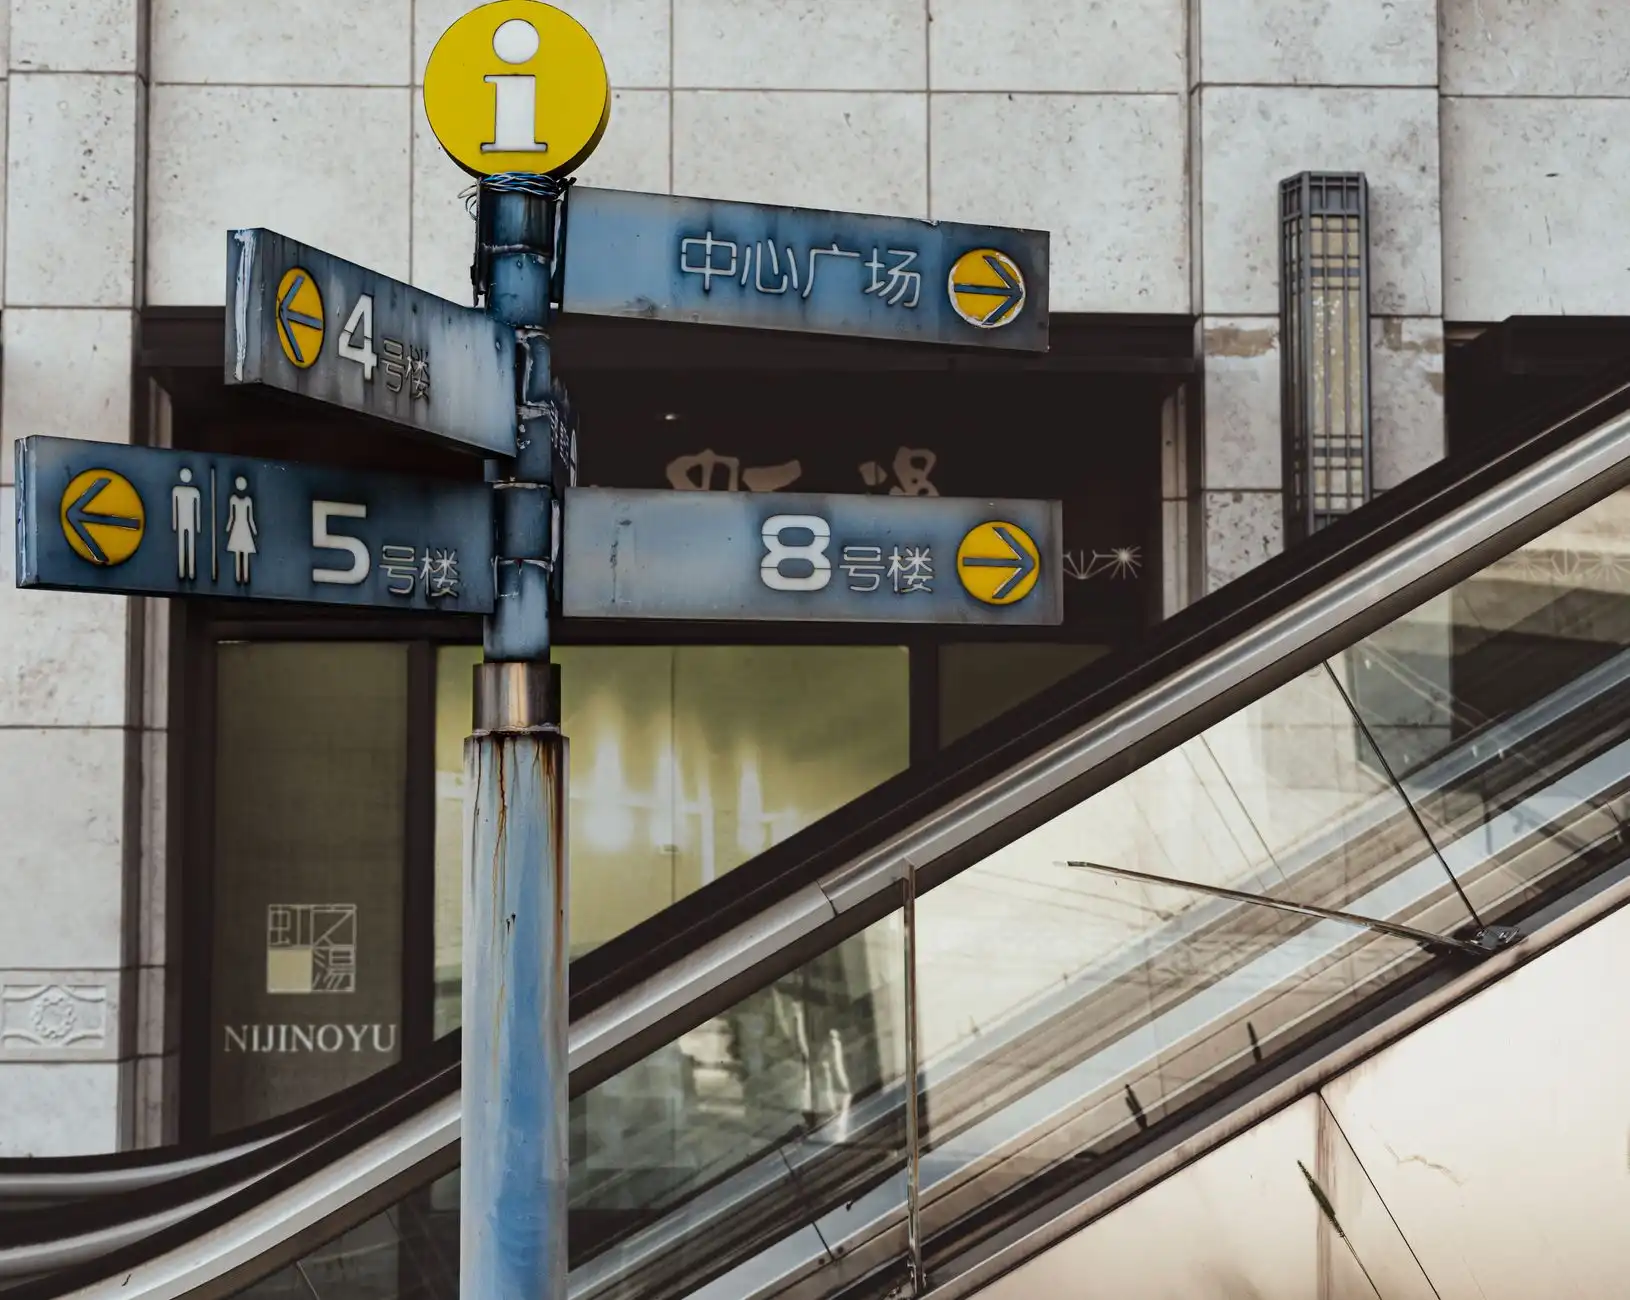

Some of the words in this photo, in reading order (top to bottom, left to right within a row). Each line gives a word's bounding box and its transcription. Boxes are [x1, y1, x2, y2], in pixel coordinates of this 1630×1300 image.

[680, 231, 921, 309] 中心广场
[338, 293, 430, 402] 4号楼
[312, 500, 458, 598] 5号楼
[760, 514, 934, 593] 8号楼
[224, 1024, 397, 1053] NIJINOYU
